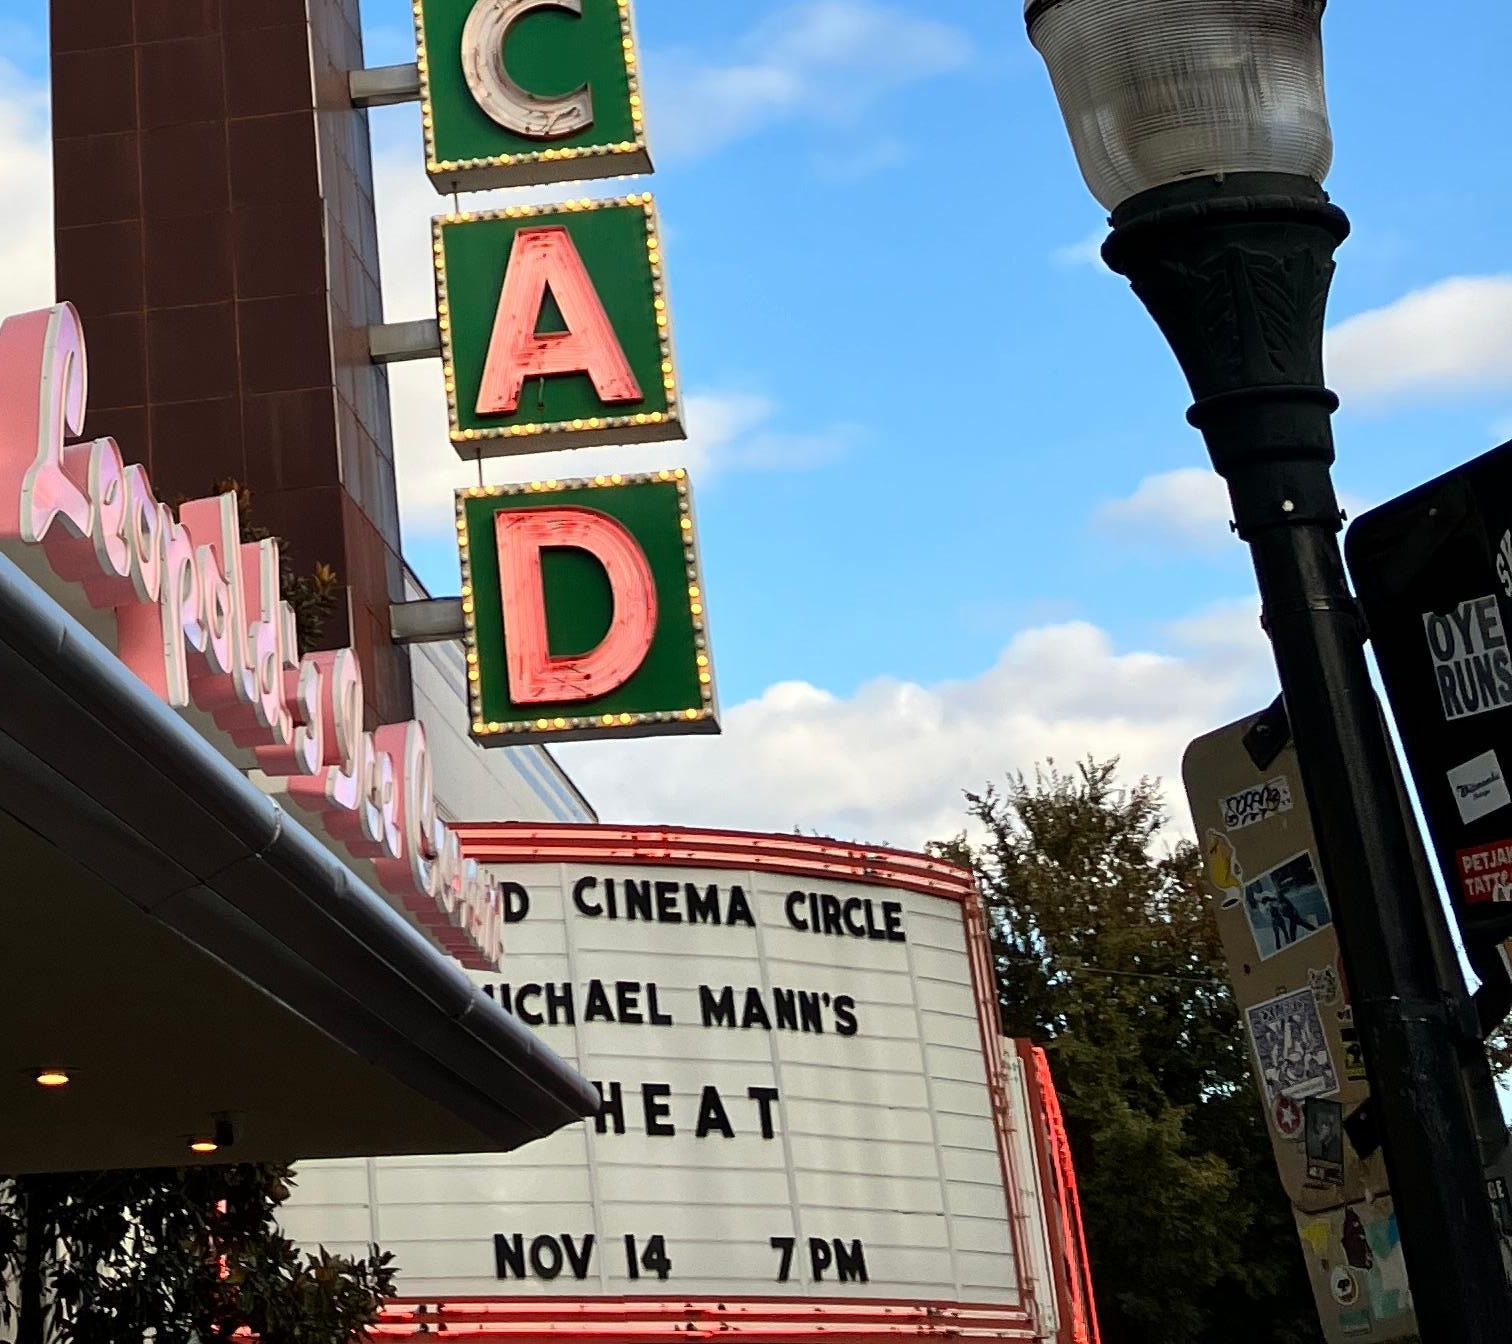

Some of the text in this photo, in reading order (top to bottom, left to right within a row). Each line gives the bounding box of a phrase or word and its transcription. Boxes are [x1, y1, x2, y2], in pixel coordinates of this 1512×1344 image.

[1427, 596, 1504, 662] OYE
[1436, 649, 1512, 717] RUNS
[572, 875, 757, 928] CINEMA
[785, 889, 907, 942] CIRCLE
[484, 979, 858, 1038] ICHAEL MANN'S
[592, 1081, 781, 1140] HEAT
[493, 1233, 870, 1284] NOV 14 7 PM
